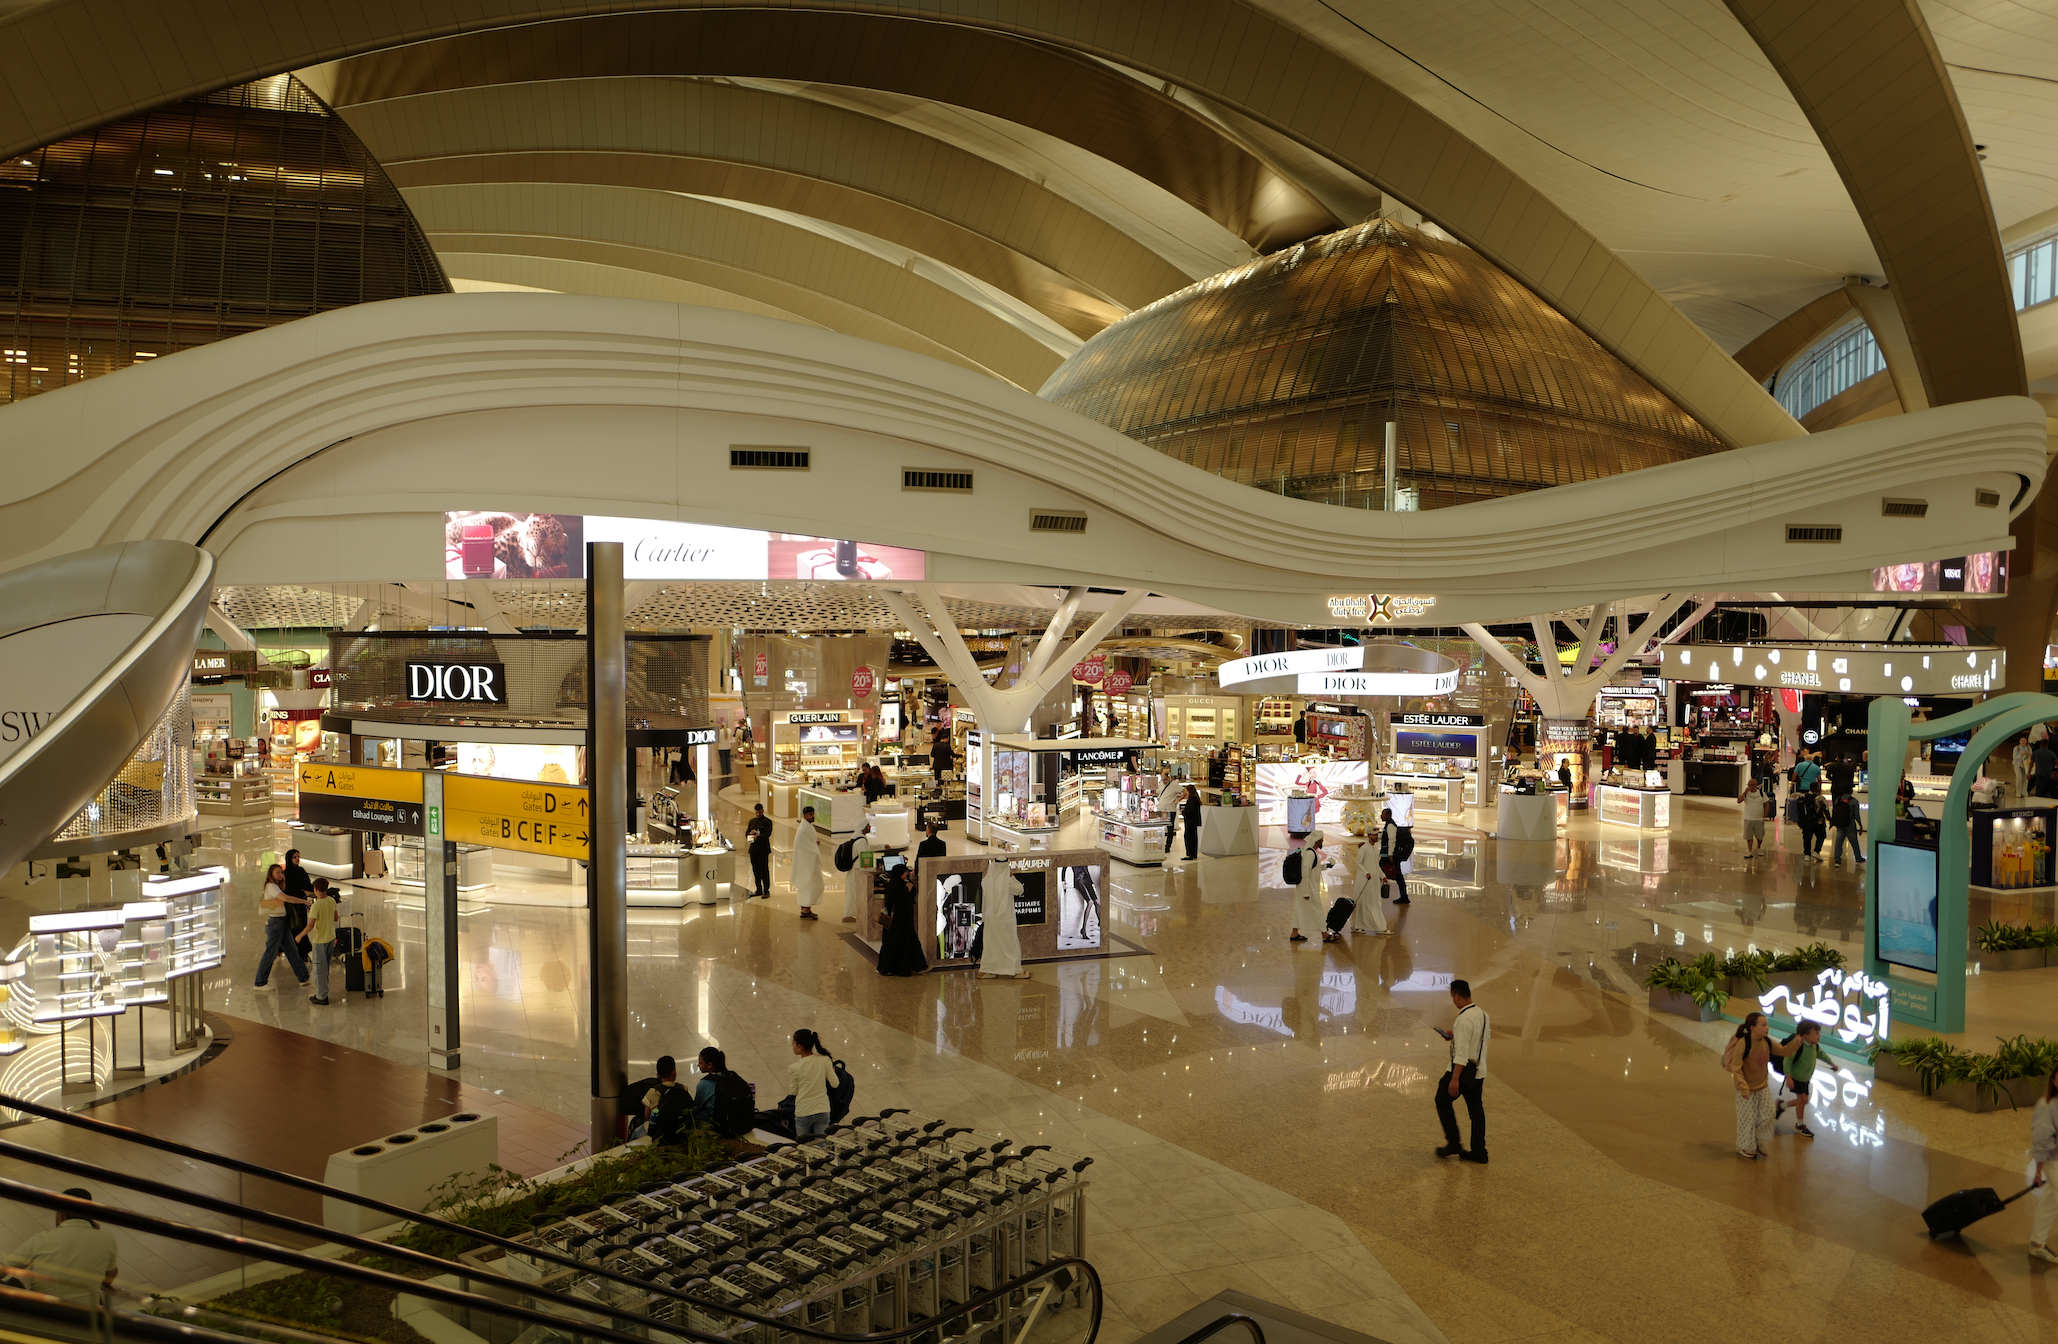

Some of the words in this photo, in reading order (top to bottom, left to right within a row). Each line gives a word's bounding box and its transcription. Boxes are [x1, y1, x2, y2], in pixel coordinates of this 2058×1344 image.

[634, 536, 715, 564] Cartier
[1328, 598, 1344, 607] Abu
[1345, 598, 1367, 607] Dhabi
[1333, 607, 1350, 618] duty
[1351, 607, 1367, 616] free
[194, 658, 207, 669] LA
[207, 658, 226, 669] MER
[1327, 652, 1348, 666] DIOR
[1084, 665, 1104, 676] 20%
[1246, 657, 1289, 675] DIOR
[409, 665, 499, 701] DIOR
[853, 675, 871, 687] 20%
[1112, 677, 1130, 686] 20%
[1325, 677, 1367, 690] DIOR
[1780, 671, 1822, 686] CHANEL
[1951, 674, 1983, 690] CHANEL
[791, 713, 839, 723] GUERLAIN
[1432, 715, 1469, 725] LAUDER
[1, 711, 60, 742] SW
[687, 730, 716, 744] DIOR
[1432, 741, 1461, 749] LAUDER
[1078, 750, 1117, 761] LANCÔME
[326, 770, 336, 789] A
[338, 781, 355, 791] Gates
[521, 790, 543, 802] البوابات
[522, 801, 543, 812] Gates
[545, 792, 556, 813] D
[352, 809, 370, 820] Etihad
[371, 812, 394, 824] Lounges
[479, 816, 500, 828] البوابات
[480, 826, 500, 837] Gates
[501, 818, 511, 838] B
[517, 821, 528, 841] C
[534, 823, 543, 843] E
[549, 824, 557, 844] F
[1014, 900, 1041, 908] ESTIAIRE
[1893, 996, 1909, 1007] your
[1909, 1000, 1928, 1011] pace
